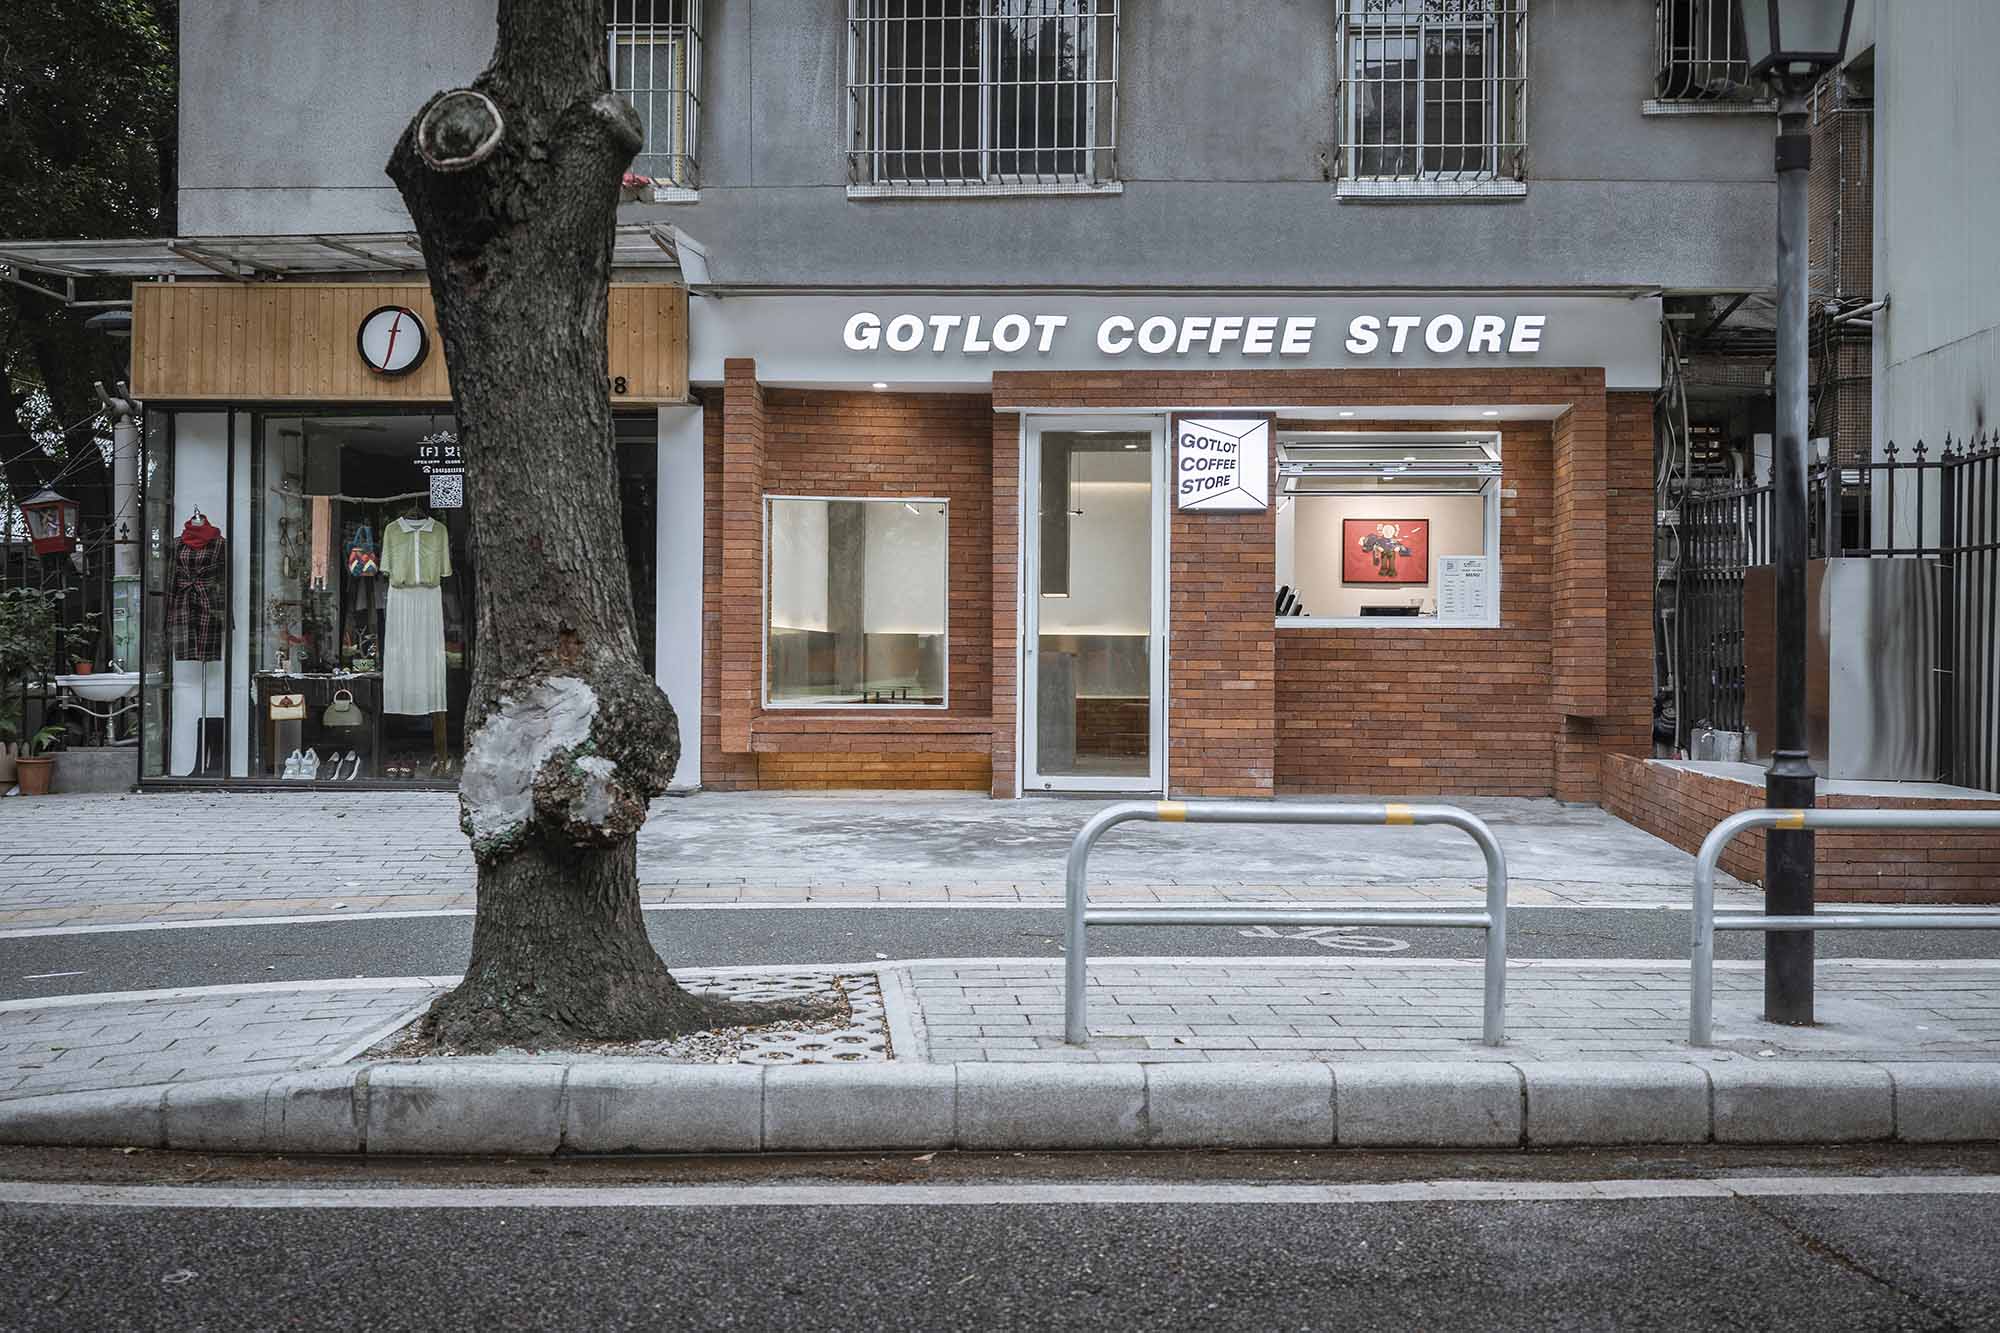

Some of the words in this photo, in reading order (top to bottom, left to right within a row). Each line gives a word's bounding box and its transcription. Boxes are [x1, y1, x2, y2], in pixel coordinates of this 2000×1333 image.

[843, 312, 1067, 352] GOTLOT
[1096, 315, 1316, 354] COFFEE
[1345, 314, 1547, 354] STORE
[607, 376, 626, 394] 8
[1180, 433, 1237, 453] GOTLOT
[1180, 457, 1237, 472] COFFEE
[1180, 475, 1231, 494] STORE
